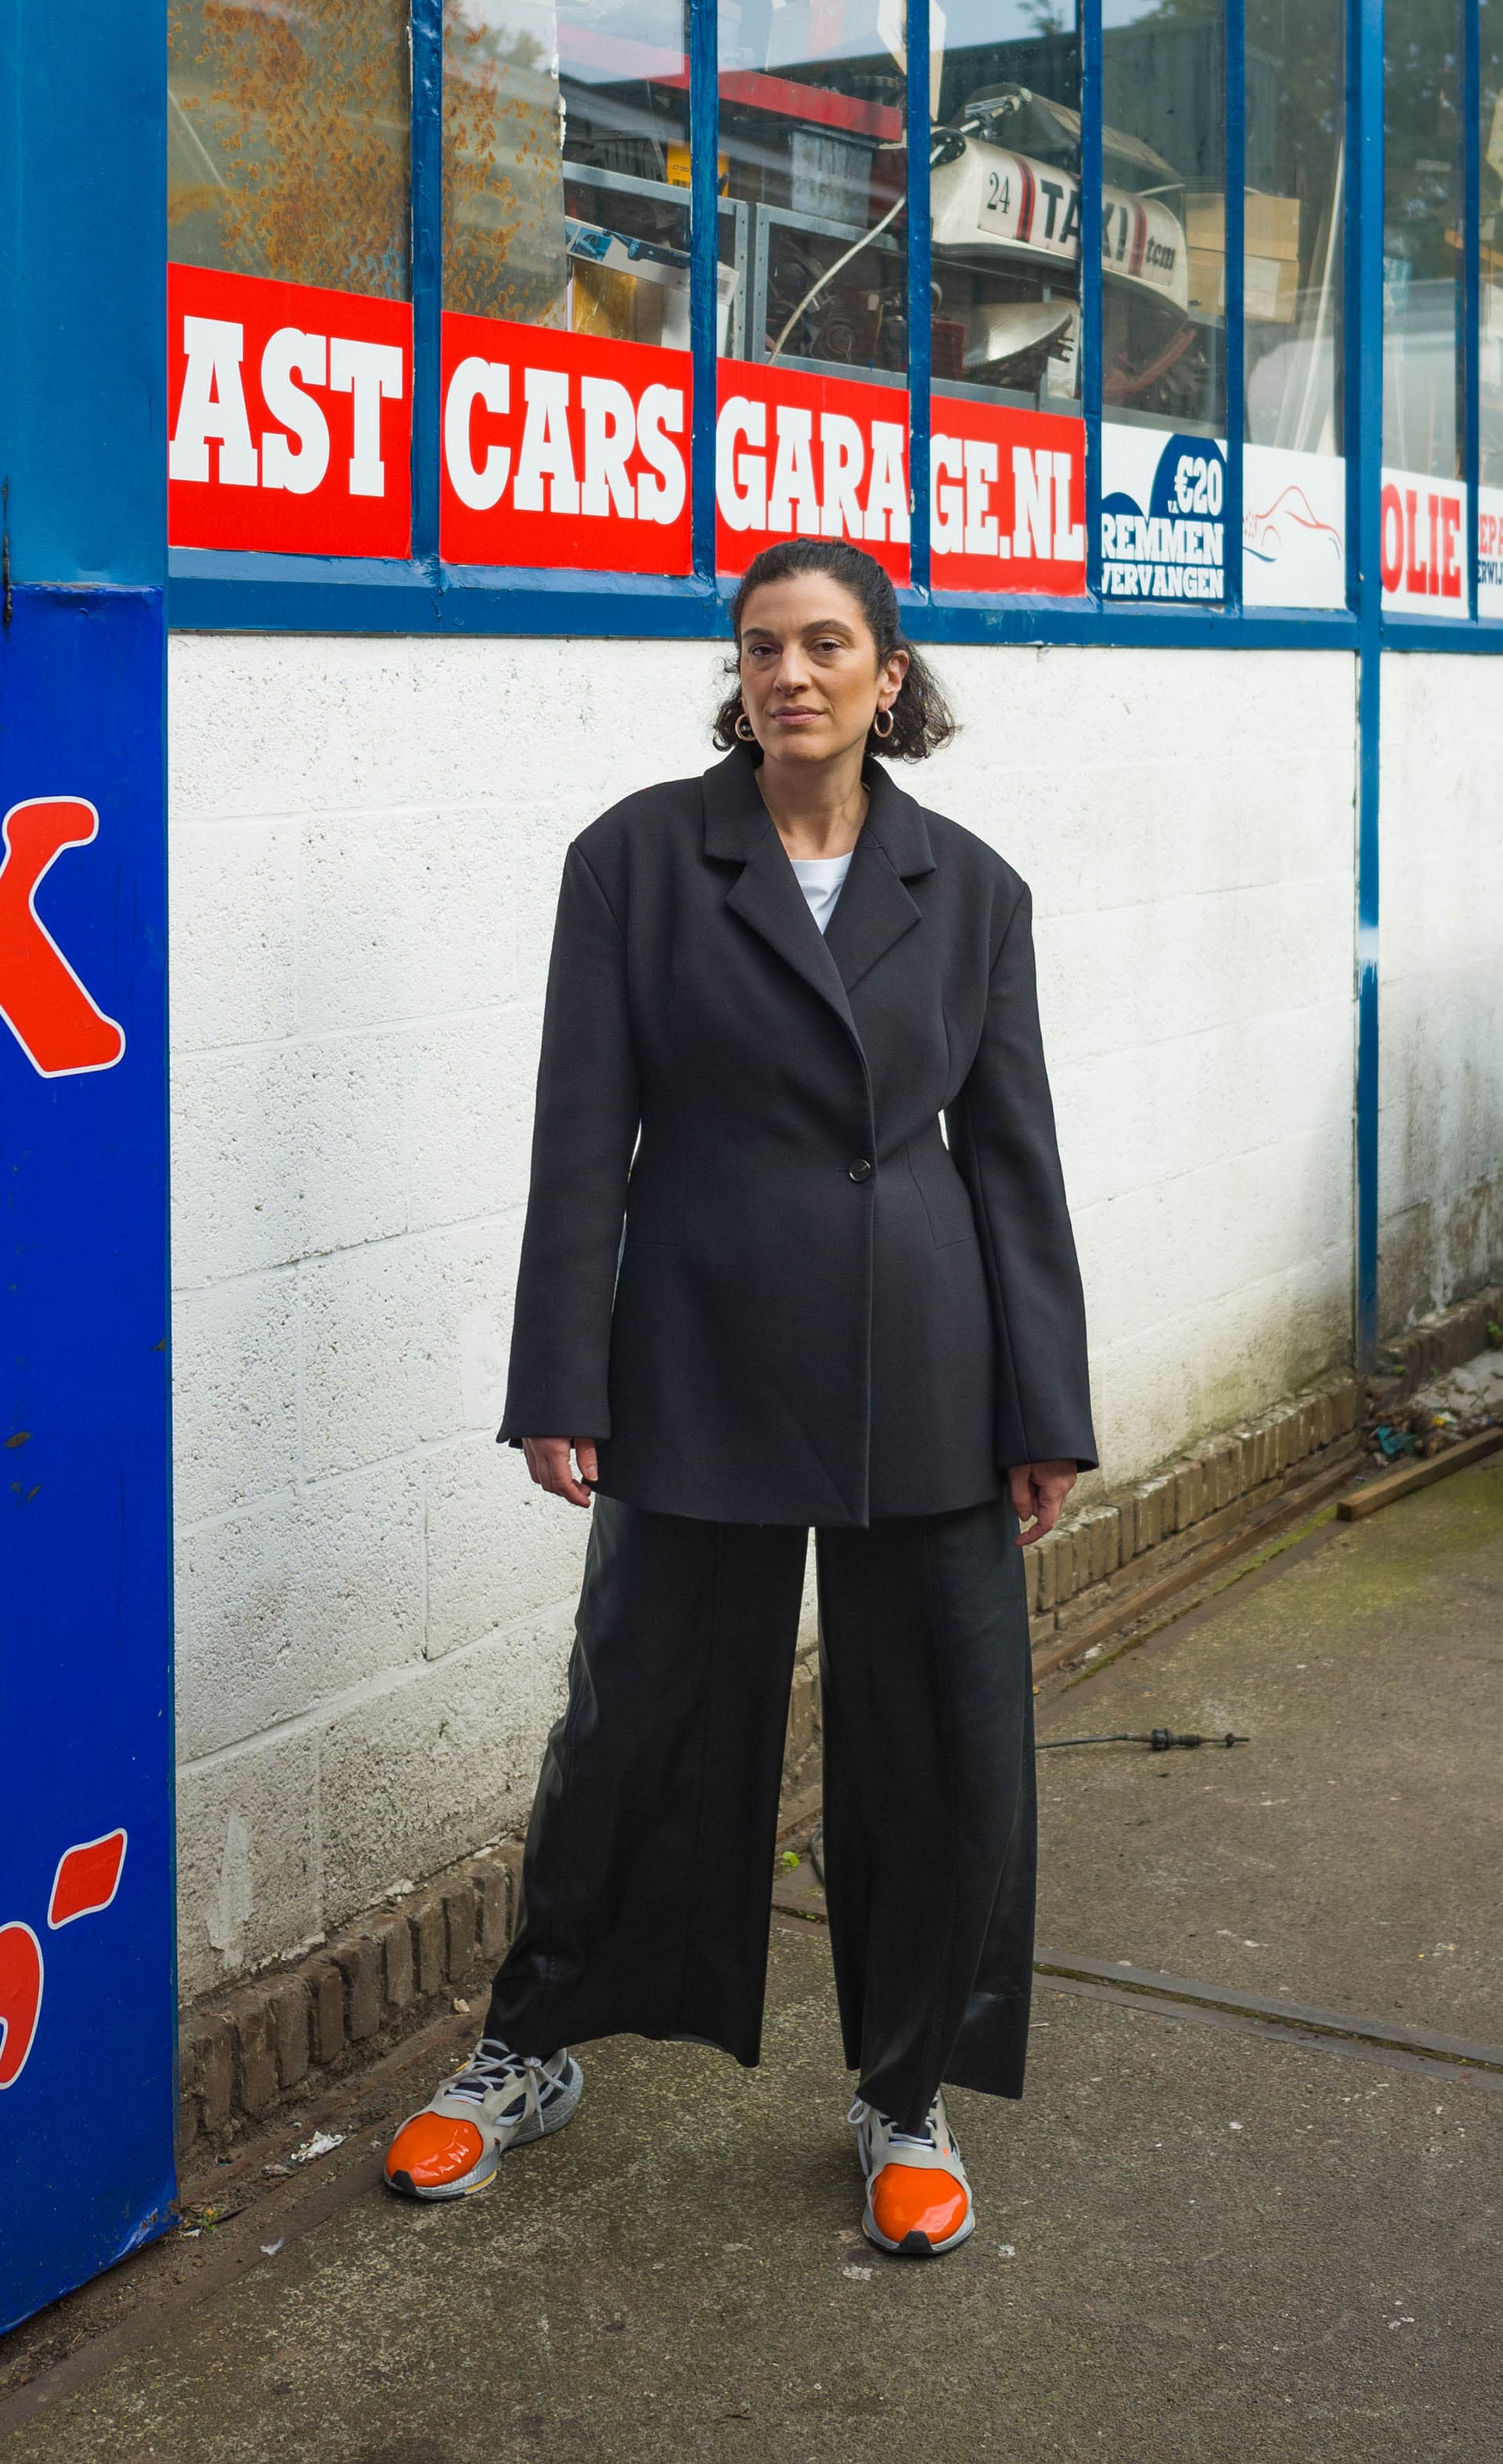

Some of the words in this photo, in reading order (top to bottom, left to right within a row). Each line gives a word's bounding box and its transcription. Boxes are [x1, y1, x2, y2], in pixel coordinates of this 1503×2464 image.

[986, 171, 1011, 214] 24
[1145, 236, 1176, 271] tcm
[168, 315, 403, 498] AST
[444, 356, 687, 525] CARS
[1174, 454, 1223, 517] €20
[1101, 561, 1224, 600] VERVANGEN
[1380, 482, 1462, 600] OLIE
